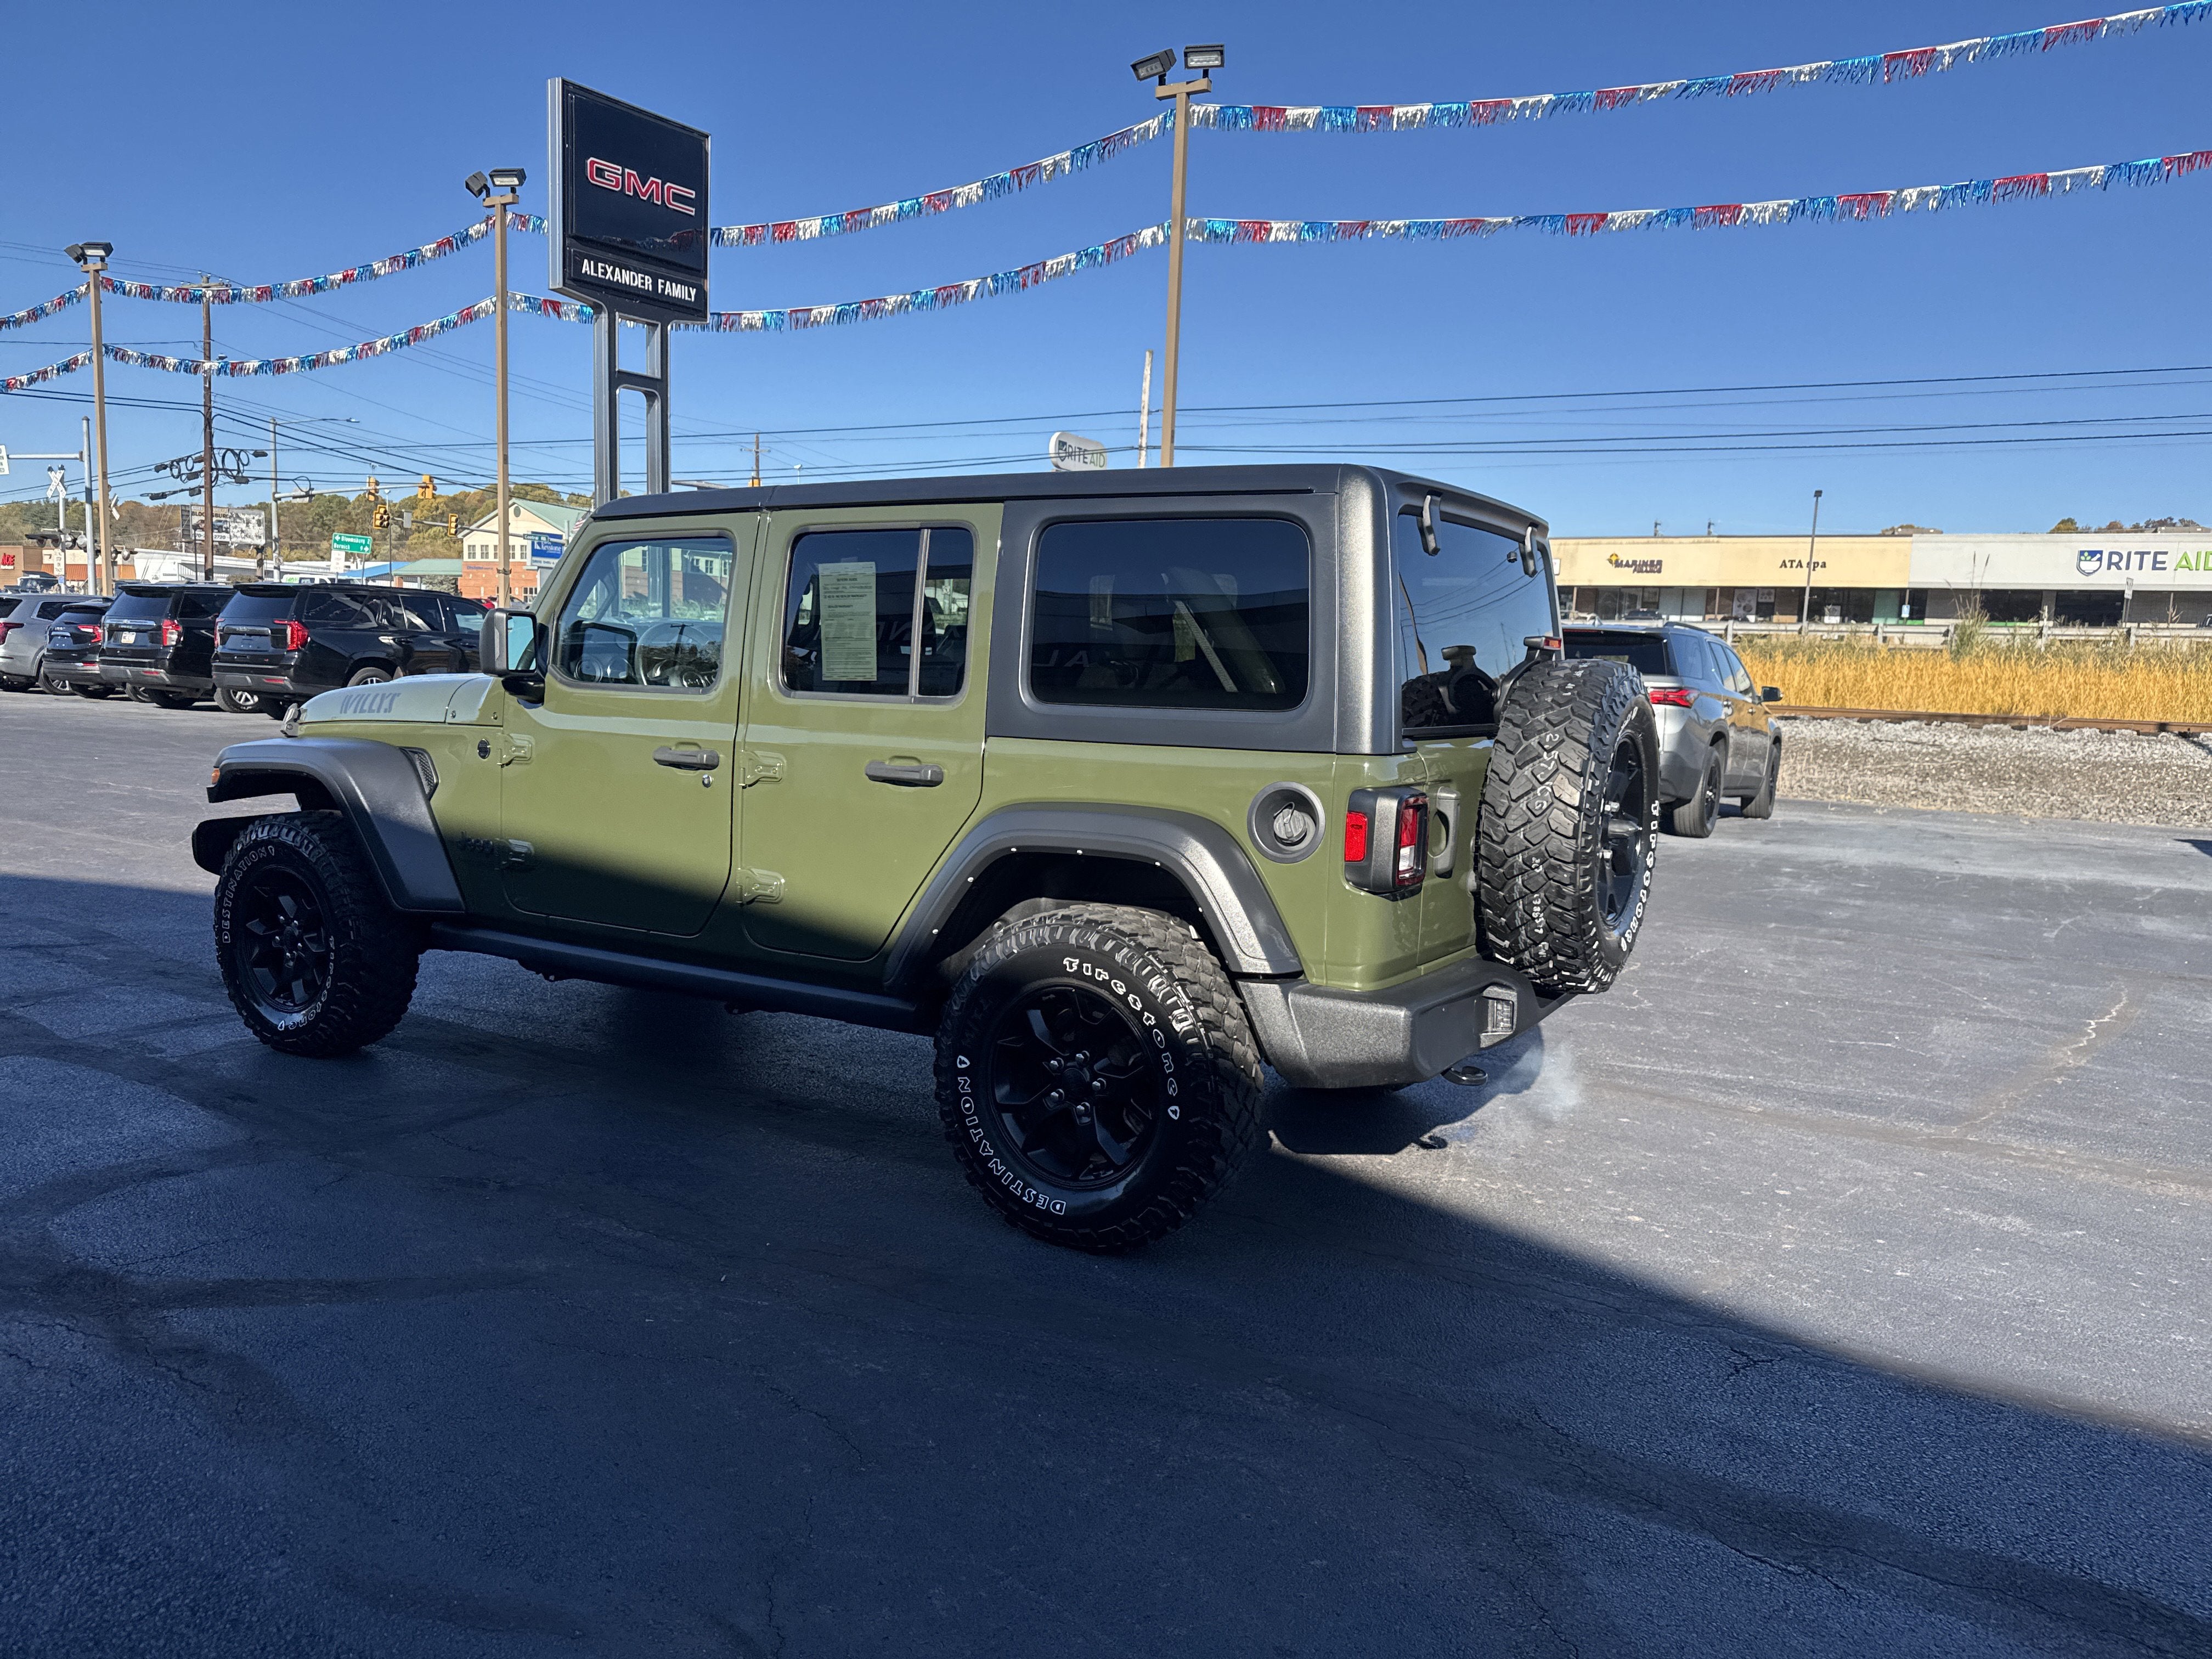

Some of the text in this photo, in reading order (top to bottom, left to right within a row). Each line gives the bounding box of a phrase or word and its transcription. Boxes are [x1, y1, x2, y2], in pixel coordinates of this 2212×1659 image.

[587, 157, 696, 216] GMC
[582, 258, 696, 302] ALEXANDER FAMILY
[1068, 444, 1105, 468] RITE AID
[341, 535, 365, 545] Bloomsburg
[1779, 559, 1804, 568] ATA
[2106, 551, 2169, 571] RITE
[340, 692, 402, 714] WILLYS
[222, 846, 266, 943] DESTINATION
[957, 1076, 1067, 1215] DESTINATION
